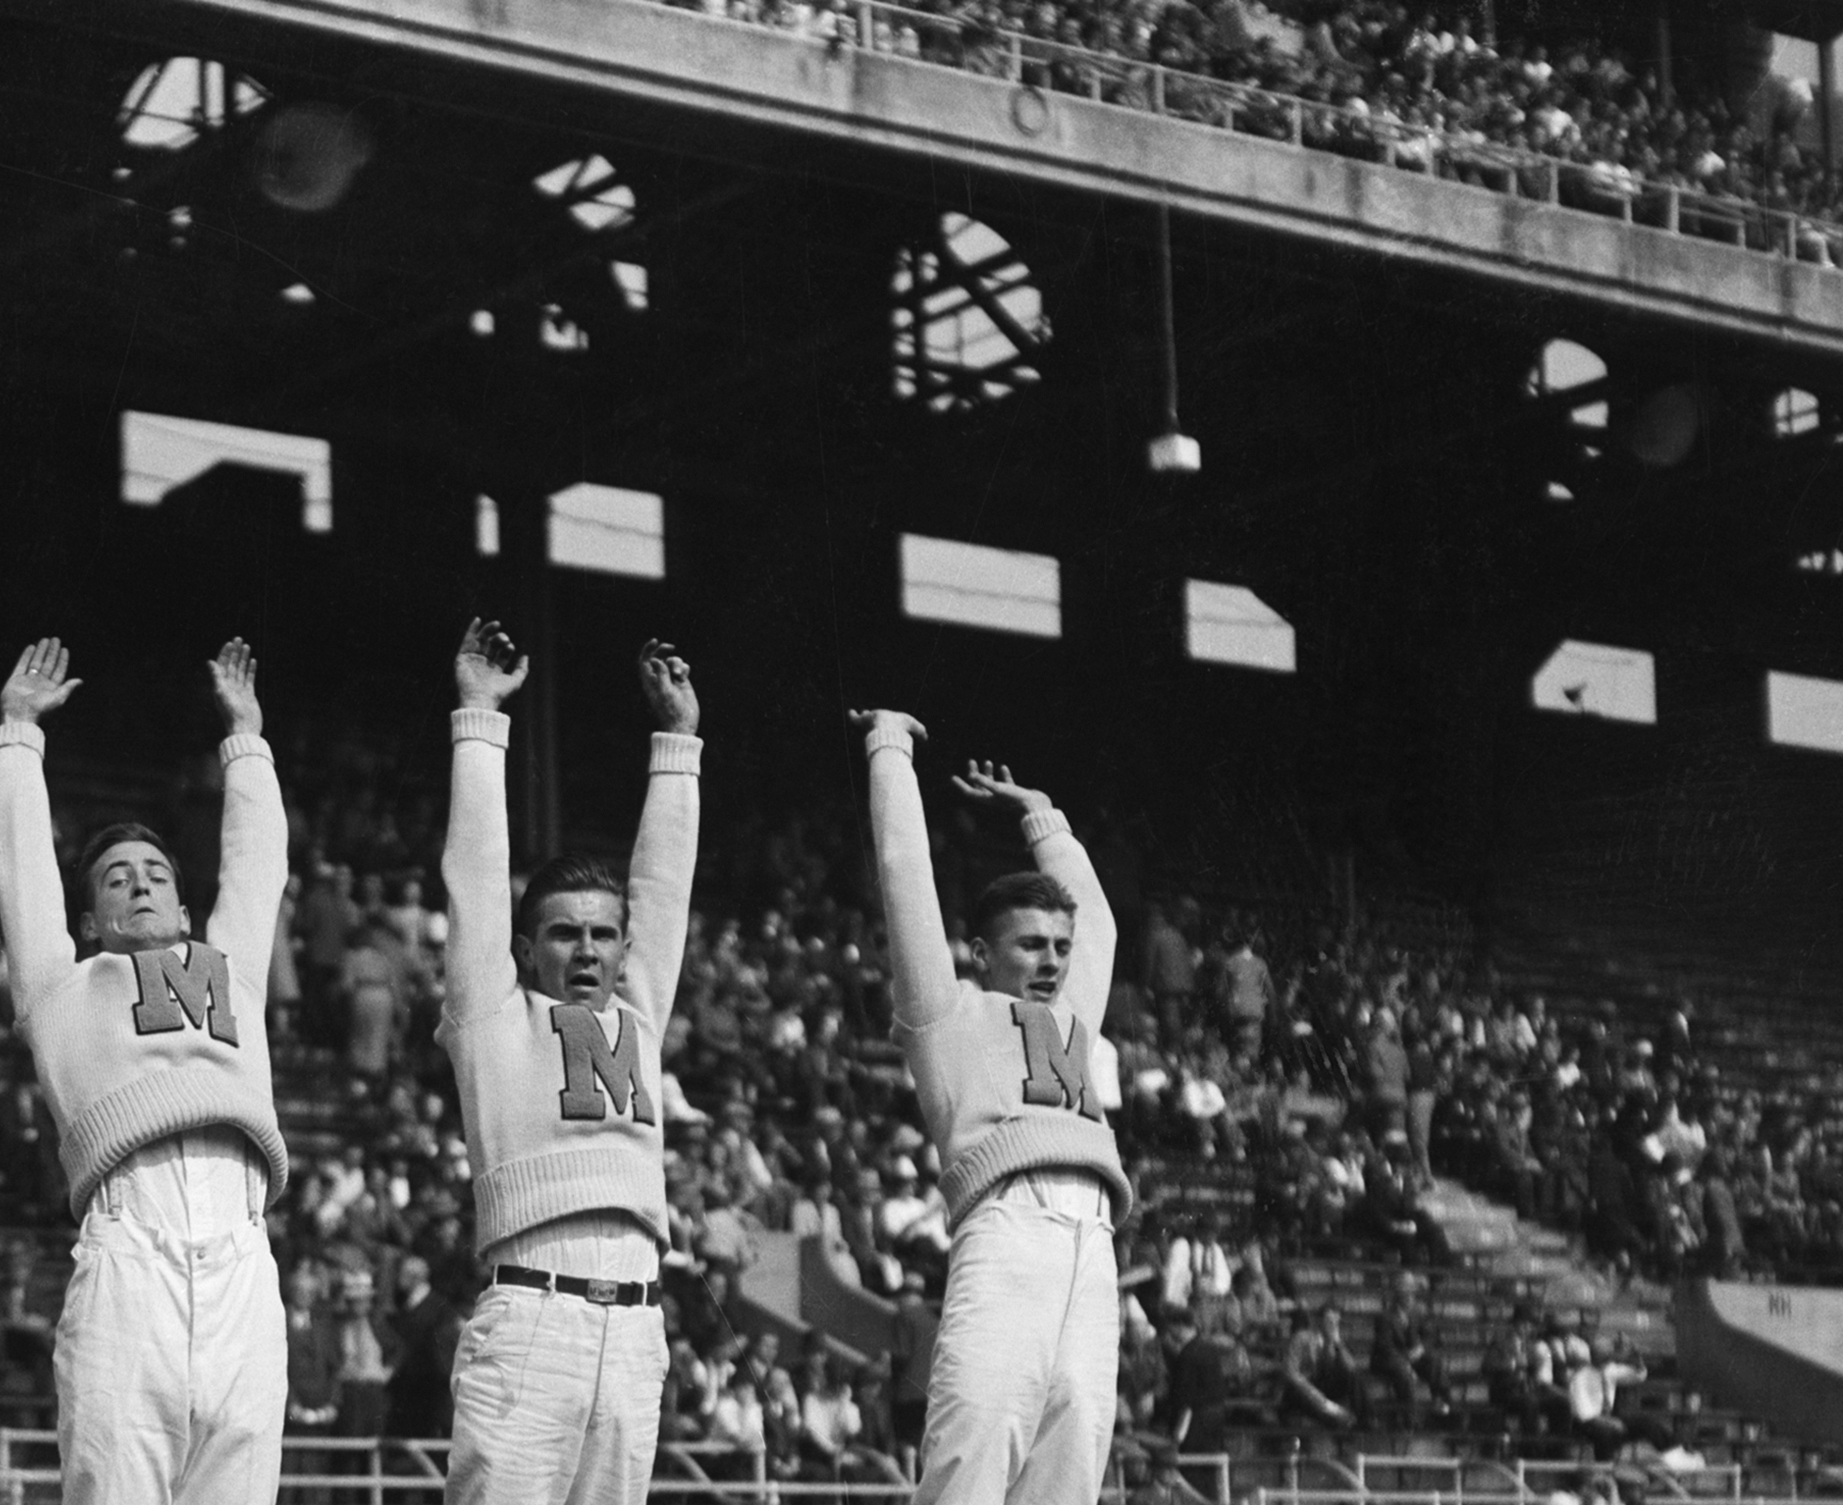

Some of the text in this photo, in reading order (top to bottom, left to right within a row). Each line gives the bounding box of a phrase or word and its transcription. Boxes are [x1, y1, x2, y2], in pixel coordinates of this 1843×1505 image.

[131, 939, 240, 1048] M
[550, 1003, 656, 1127] M
[1010, 1002, 1103, 1123] M
